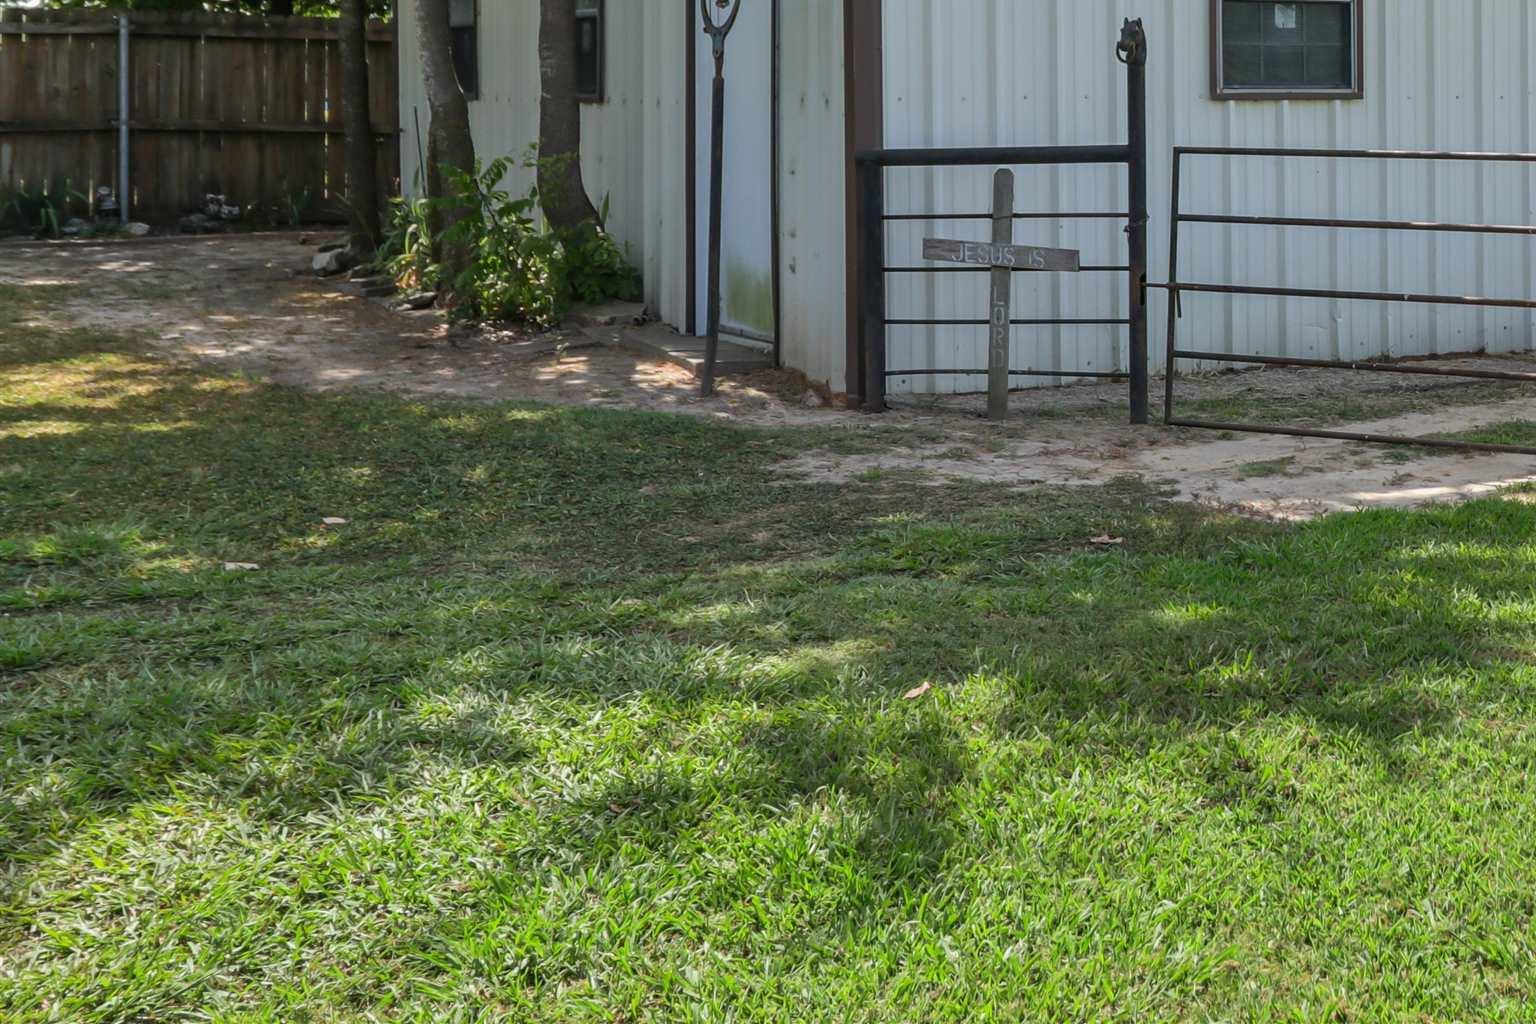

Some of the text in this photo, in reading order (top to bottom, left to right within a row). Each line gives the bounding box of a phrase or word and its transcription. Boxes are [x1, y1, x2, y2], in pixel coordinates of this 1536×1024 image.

[951, 242, 1046, 268] JESUS IS
[991, 284, 1006, 368] LORD
